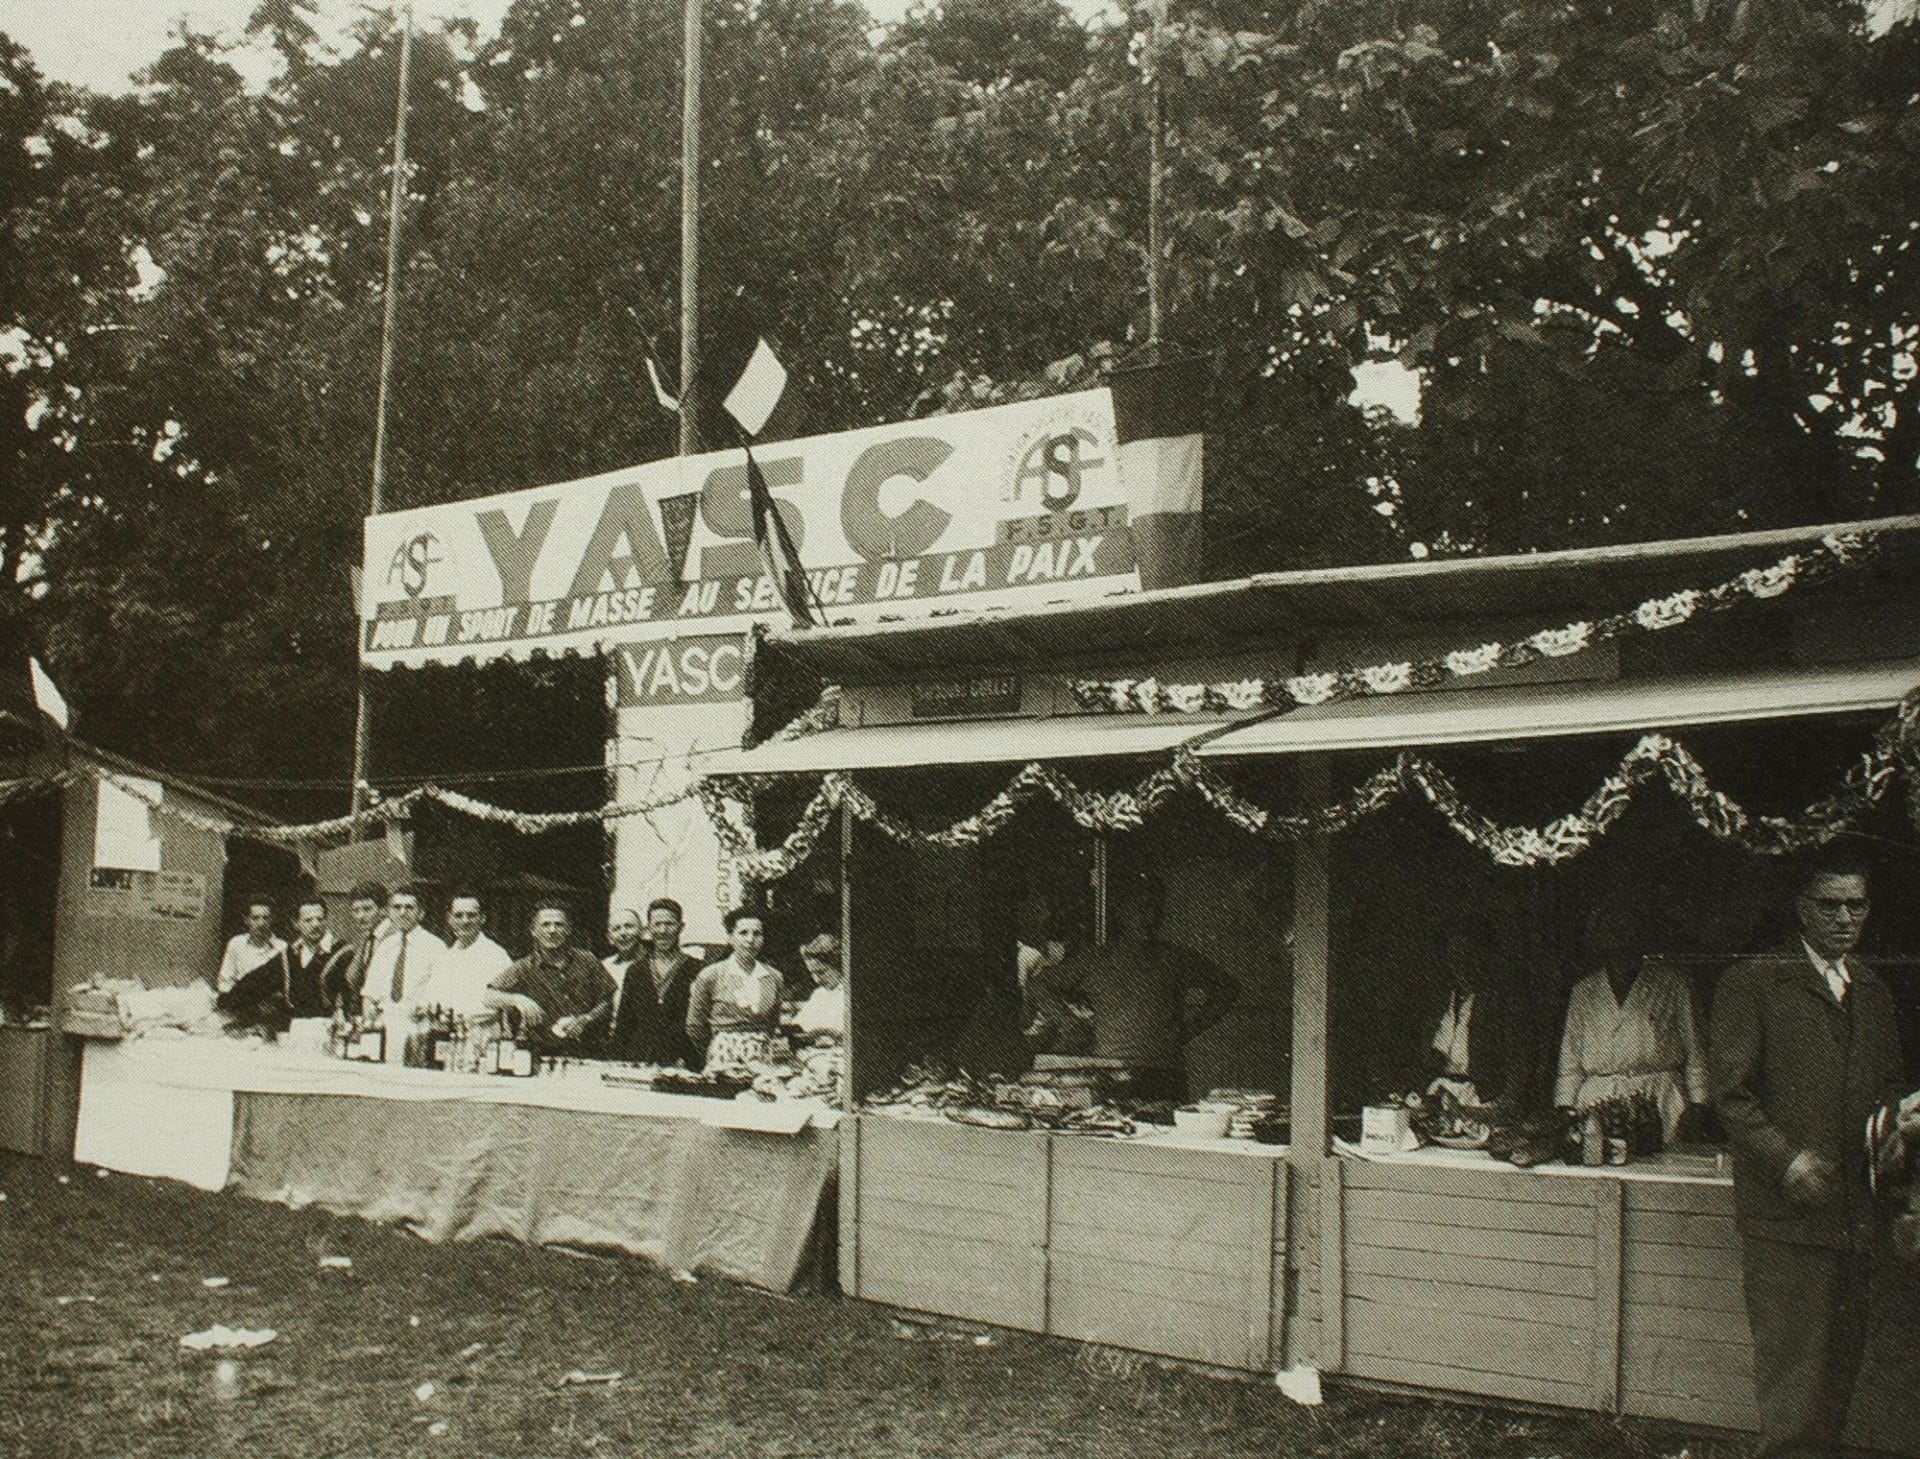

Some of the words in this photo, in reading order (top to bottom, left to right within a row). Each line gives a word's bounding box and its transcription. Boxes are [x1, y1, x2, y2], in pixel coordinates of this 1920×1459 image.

[475, 436, 956, 608] YASC
[526, 601, 557, 636] DE
[568, 587, 657, 630] MASSE
[678, 580, 721, 617] AU
[733, 565, 859, 610] SEICE
[874, 558, 919, 601] DE
[938, 551, 987, 594] LA
[1006, 535, 1104, 584] PAIX
[623, 644, 741, 698] YASC
